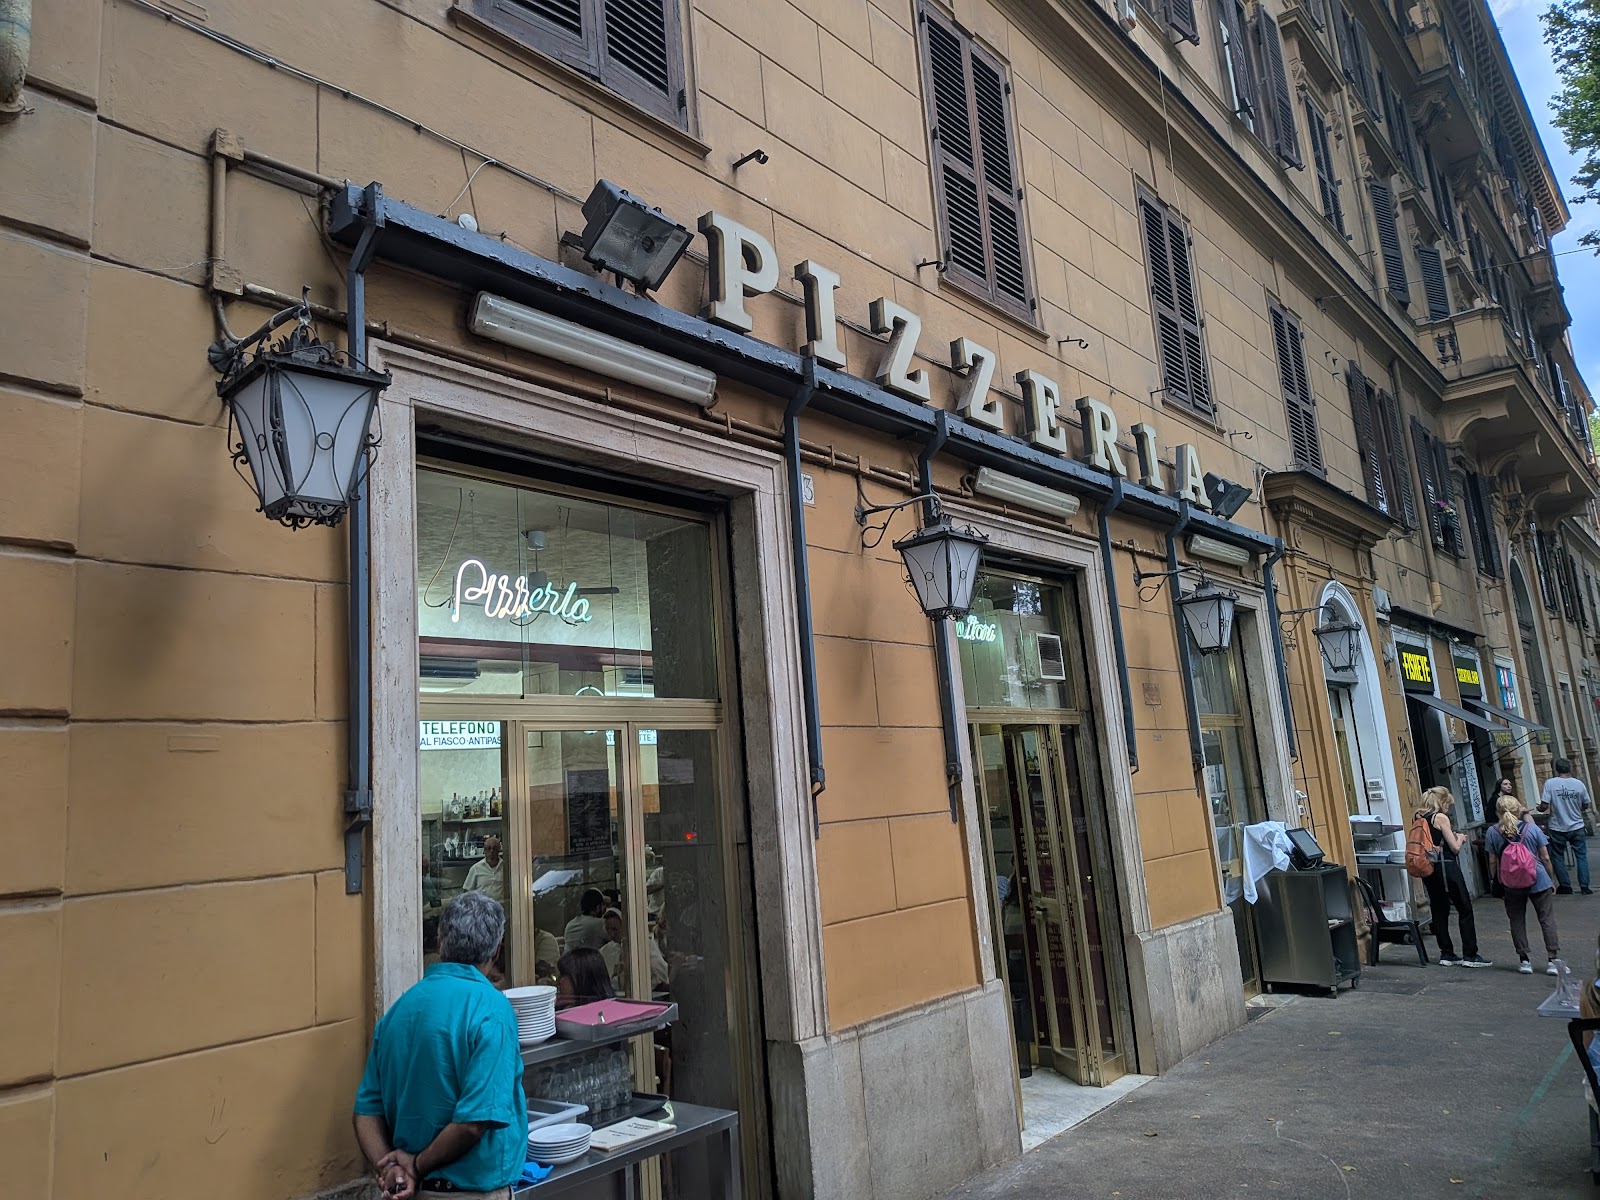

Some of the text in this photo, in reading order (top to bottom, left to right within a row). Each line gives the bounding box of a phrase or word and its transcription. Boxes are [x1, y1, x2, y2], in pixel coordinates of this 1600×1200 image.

[697, 210, 1212, 511] PIZZERIA
[451, 559, 593, 623] Pizzeria
[419, 737, 433, 746] AL
[422, 721, 496, 735] TELEFONO
